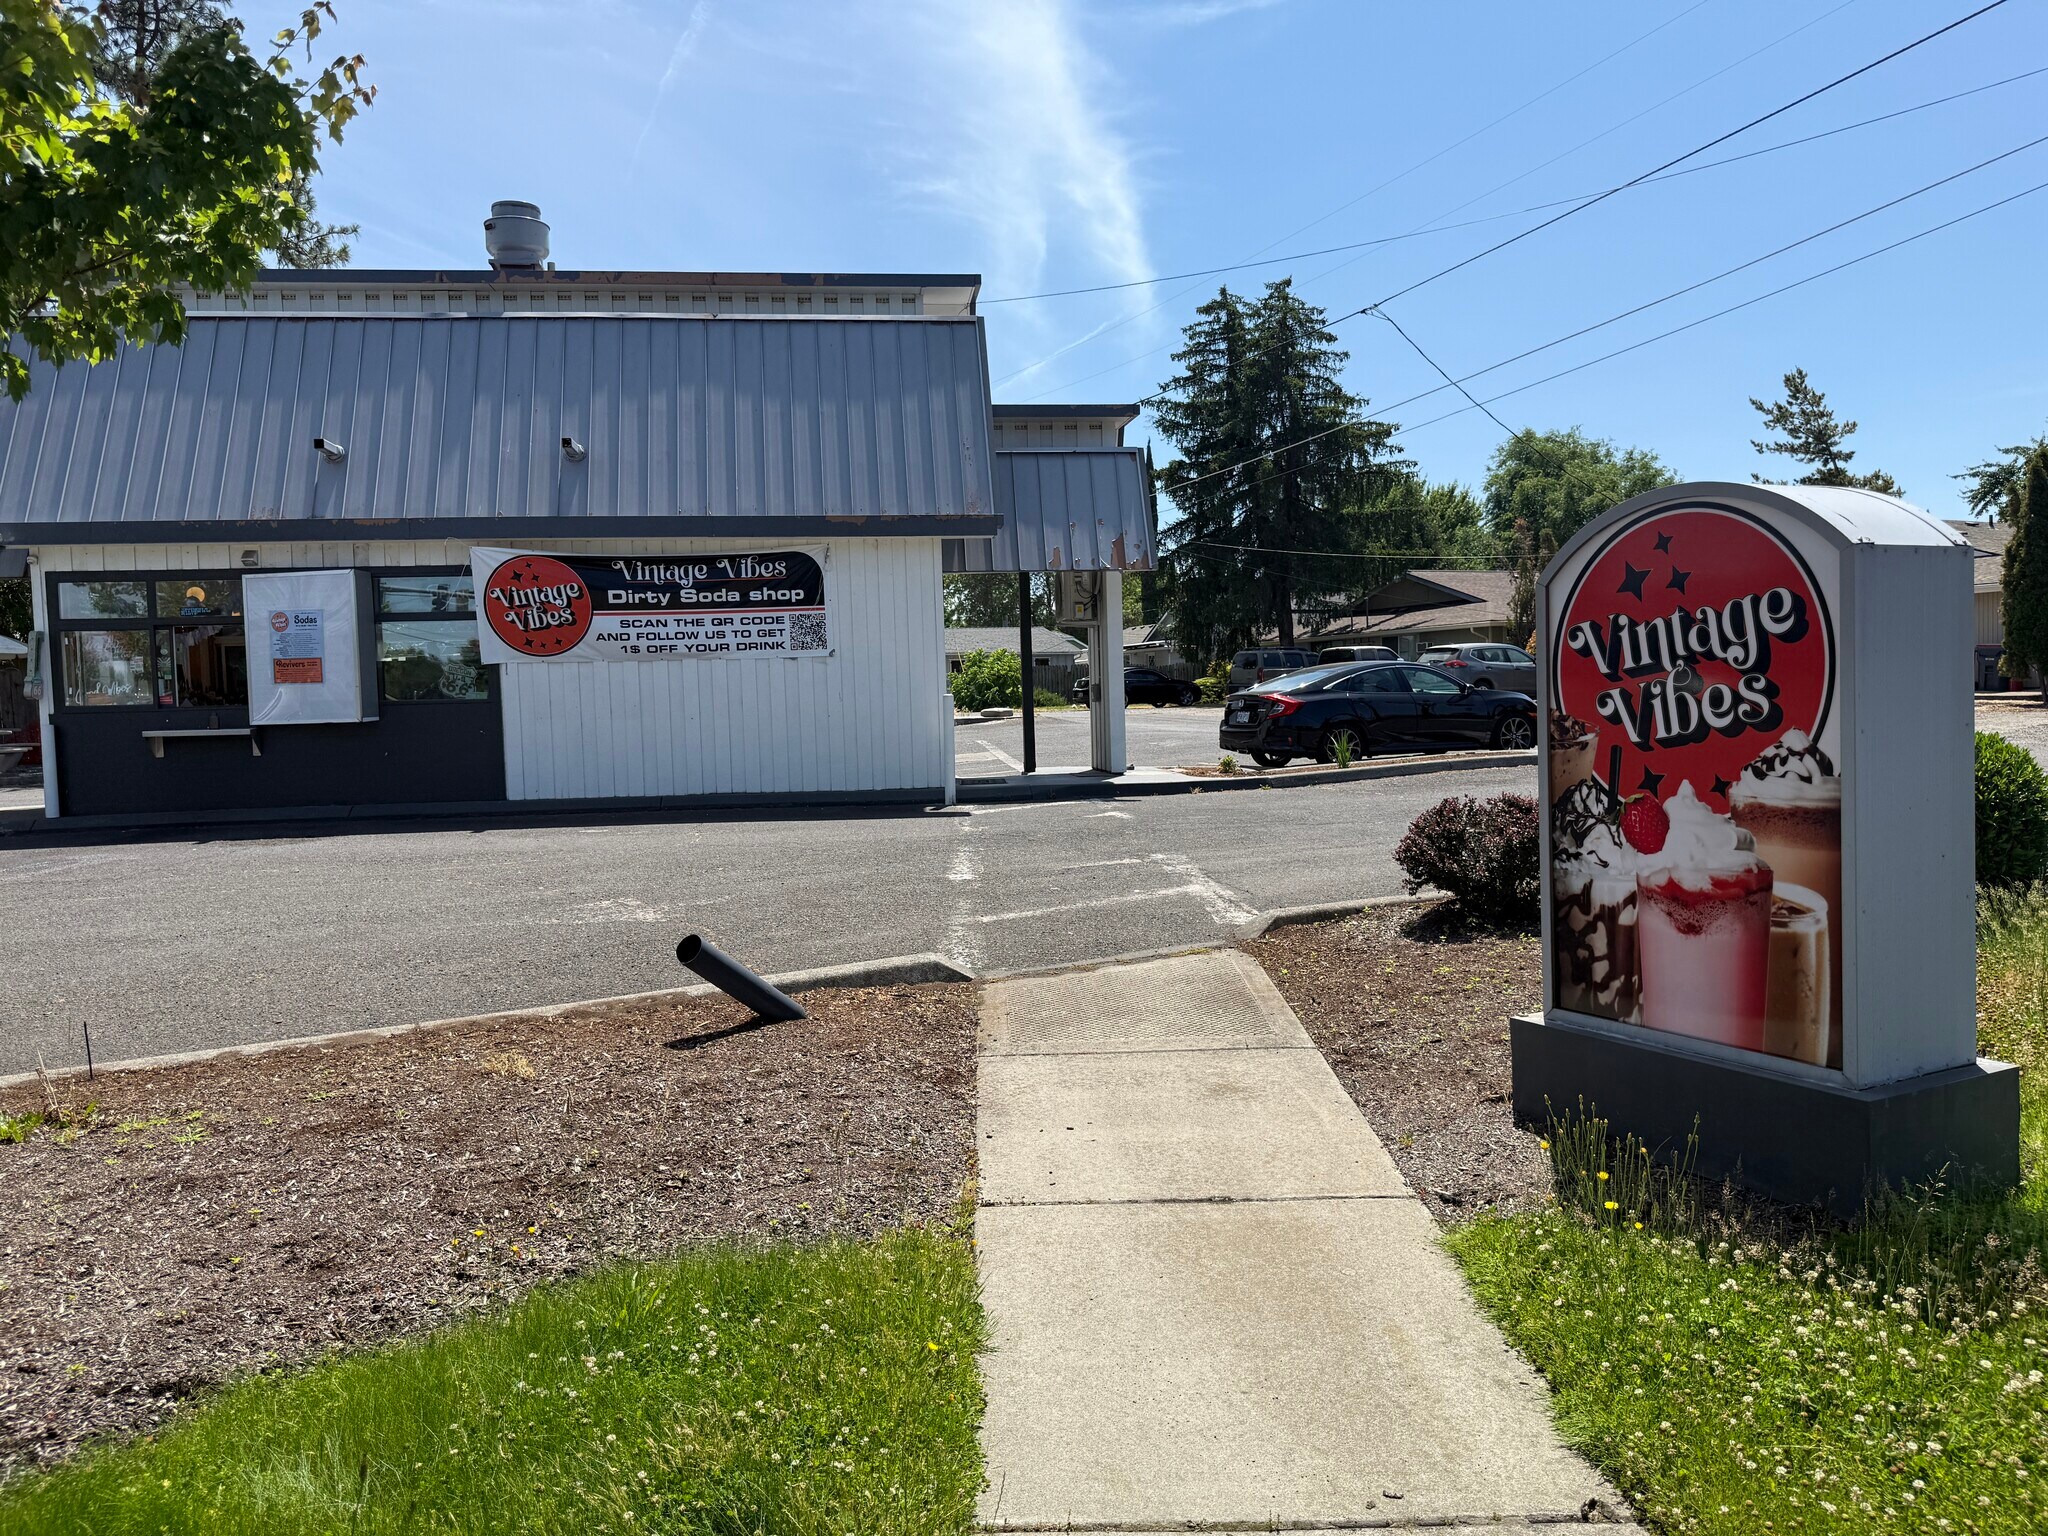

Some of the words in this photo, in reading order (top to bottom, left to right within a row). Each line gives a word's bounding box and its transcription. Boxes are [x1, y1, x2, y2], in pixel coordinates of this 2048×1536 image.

[611, 559, 708, 588] Vintage
[716, 555, 788, 579] Vibes
[489, 582, 580, 610] Vintage
[607, 588, 669, 607] Dirty
[680, 588, 741, 603] Soda
[749, 587, 805, 604] shop
[294, 615, 318, 624] Sodas
[504, 602, 574, 632] Vibes
[619, 618, 669, 629] SCAN
[673, 617, 707, 628] THE
[711, 617, 735, 627] QR
[739, 615, 786, 626] CODE
[596, 632, 631, 642] AND
[636, 630, 701, 641] FOLLOW
[705, 630, 726, 640] US
[731, 629, 752, 640] TO
[756, 628, 786, 639] GET
[1567, 586, 1797, 676] Vintage
[620, 643, 641, 654] 1$
[645, 643, 678, 654] OFF
[684, 642, 732, 653] YOUR
[736, 640, 787, 652] DRINK
[275, 660, 306, 669] Revivers
[33, 686, 42, 696] 66
[1597, 660, 1773, 747] Vibes
